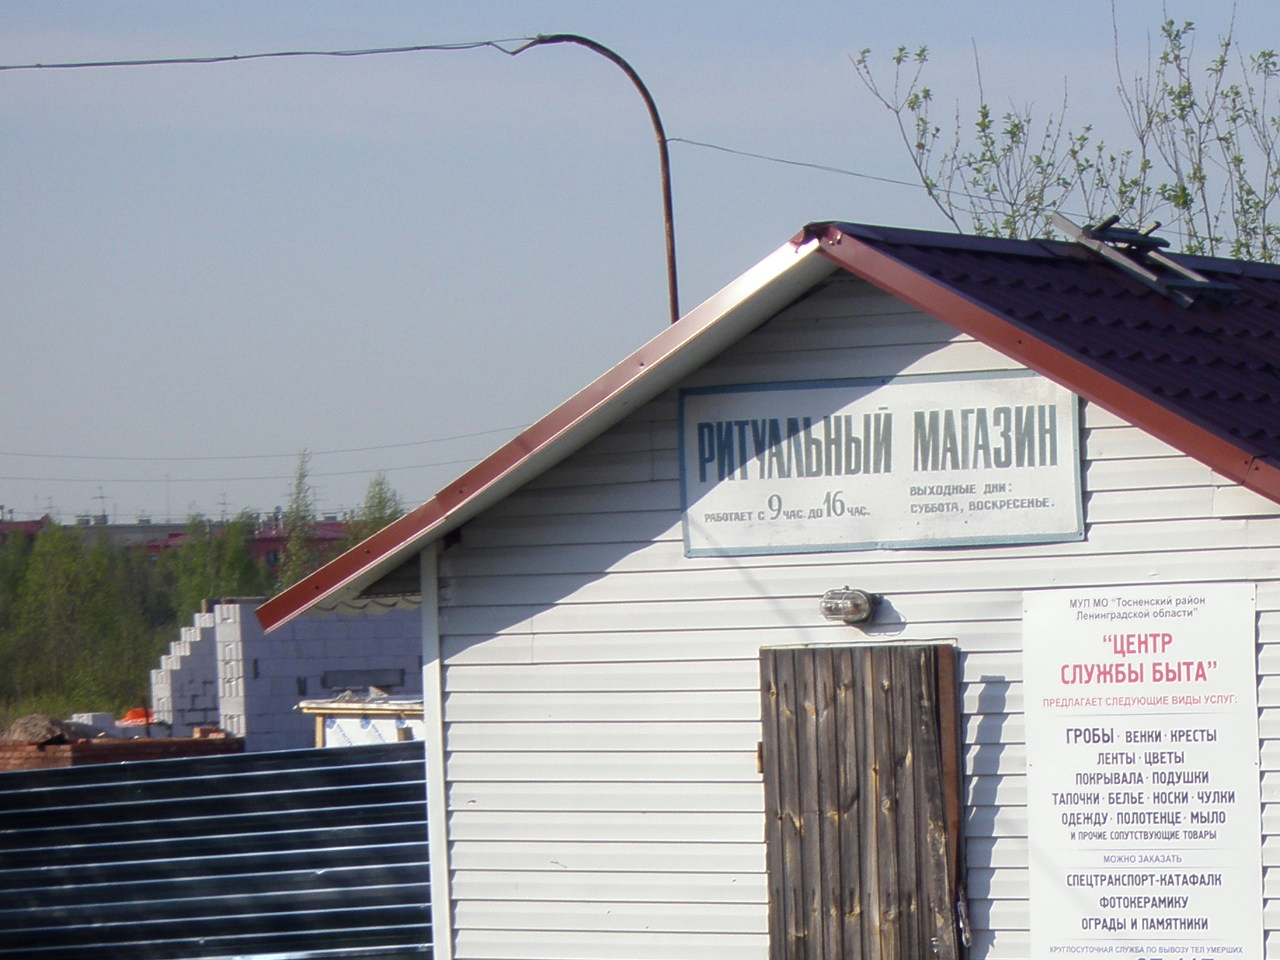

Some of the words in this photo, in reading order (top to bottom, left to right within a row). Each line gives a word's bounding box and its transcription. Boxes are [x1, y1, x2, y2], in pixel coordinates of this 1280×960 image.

[697, 406, 893, 483] РИТУАЛЬНЫЙ
[912, 403, 1058, 472] МАГАЗИН
[910, 483, 977, 497] ВЫХОДНЫЕ
[983, 481, 1012, 496] ДНИ:
[704, 509, 754, 523] РАБОТАЕТ
[767, 493, 783, 520] 9
[824, 490, 846, 518] 16
[910, 499, 965, 515] СУББОТА,
[968, 495, 1055, 511] ВОСКРЕСЕНЬЕ.
[1070, 598, 1090, 608] МУП
[1093, 598, 1109, 608] МО
[1175, 596, 1206, 607] район
[1076, 609, 1150, 621] Ленинградской
[1103, 633, 1173, 657] “ЦЕНТР
[1060, 663, 1144, 685] СЛУЖБЫ
[1152, 660, 1217, 683] БЫТА”
[1043, 697, 1103, 708] ПРЕДЛАГАЕТ
[1105, 696, 1169, 707] СЛЕДУЮЩИЕ
[1172, 695, 1201, 705] ВИДЫ
[1204, 694, 1238, 705] УСЛУГ:
[1066, 728, 1114, 744] ГРОБЫ
[1125, 730, 1162, 743] ВЕНКИ
[1170, 729, 1217, 742] КРЕСТЫ
[1097, 752, 1136, 765] ЛЕНТЫ
[1144, 752, 1185, 766] ЦВЕТЫ
[1075, 772, 1144, 785] ПОКРЫВАЛА
[1152, 771, 1209, 786] ПОДУШКИ
[1052, 793, 1100, 805] ТАПОЧКИ
[1108, 792, 1144, 804] БЕЛЬЕ
[1153, 792, 1189, 804] НОСКИ
[1197, 791, 1236, 804] ЧУЛКИ
[1061, 812, 1109, 827] ОДЕЖДУ
[1116, 811, 1182, 826] ПОЛОТЕНЦЕ
[1190, 811, 1226, 824] МЫЛО
[1070, 832, 1076, 840] И
[1078, 831, 1107, 840] ПРОЧИЕ
[1110, 830, 1180, 841] СОПУТСТВУЮЩИЕ
[1183, 830, 1217, 840] ТОВАРЫ
[1103, 855, 1136, 863] МОЖНО
[1138, 855, 1183, 863] ЗАКАЗАТЬ
[1066, 873, 1222, 888] СПЕЦТРАНСПОРТ-КАТАФАЛК
[1099, 896, 1189, 909] ФОТОКЕРАМИКУ
[1081, 918, 1127, 932] ОГРАДЫ
[1131, 918, 1138, 930] И
[1142, 918, 1209, 931] ПАМЯТНИКИ
[1050, 946, 1113, 954] КРУГЛОСУТОЧНАЯ
[1115, 946, 1145, 954] СЛУЖБА
[1146, 946, 1157, 954] ПО
[1159, 946, 1189, 954] ВЫВОЗУ
[1191, 946, 1205, 954] ТЕЛ
[1206, 946, 1243, 954] УМЕРШИХ
